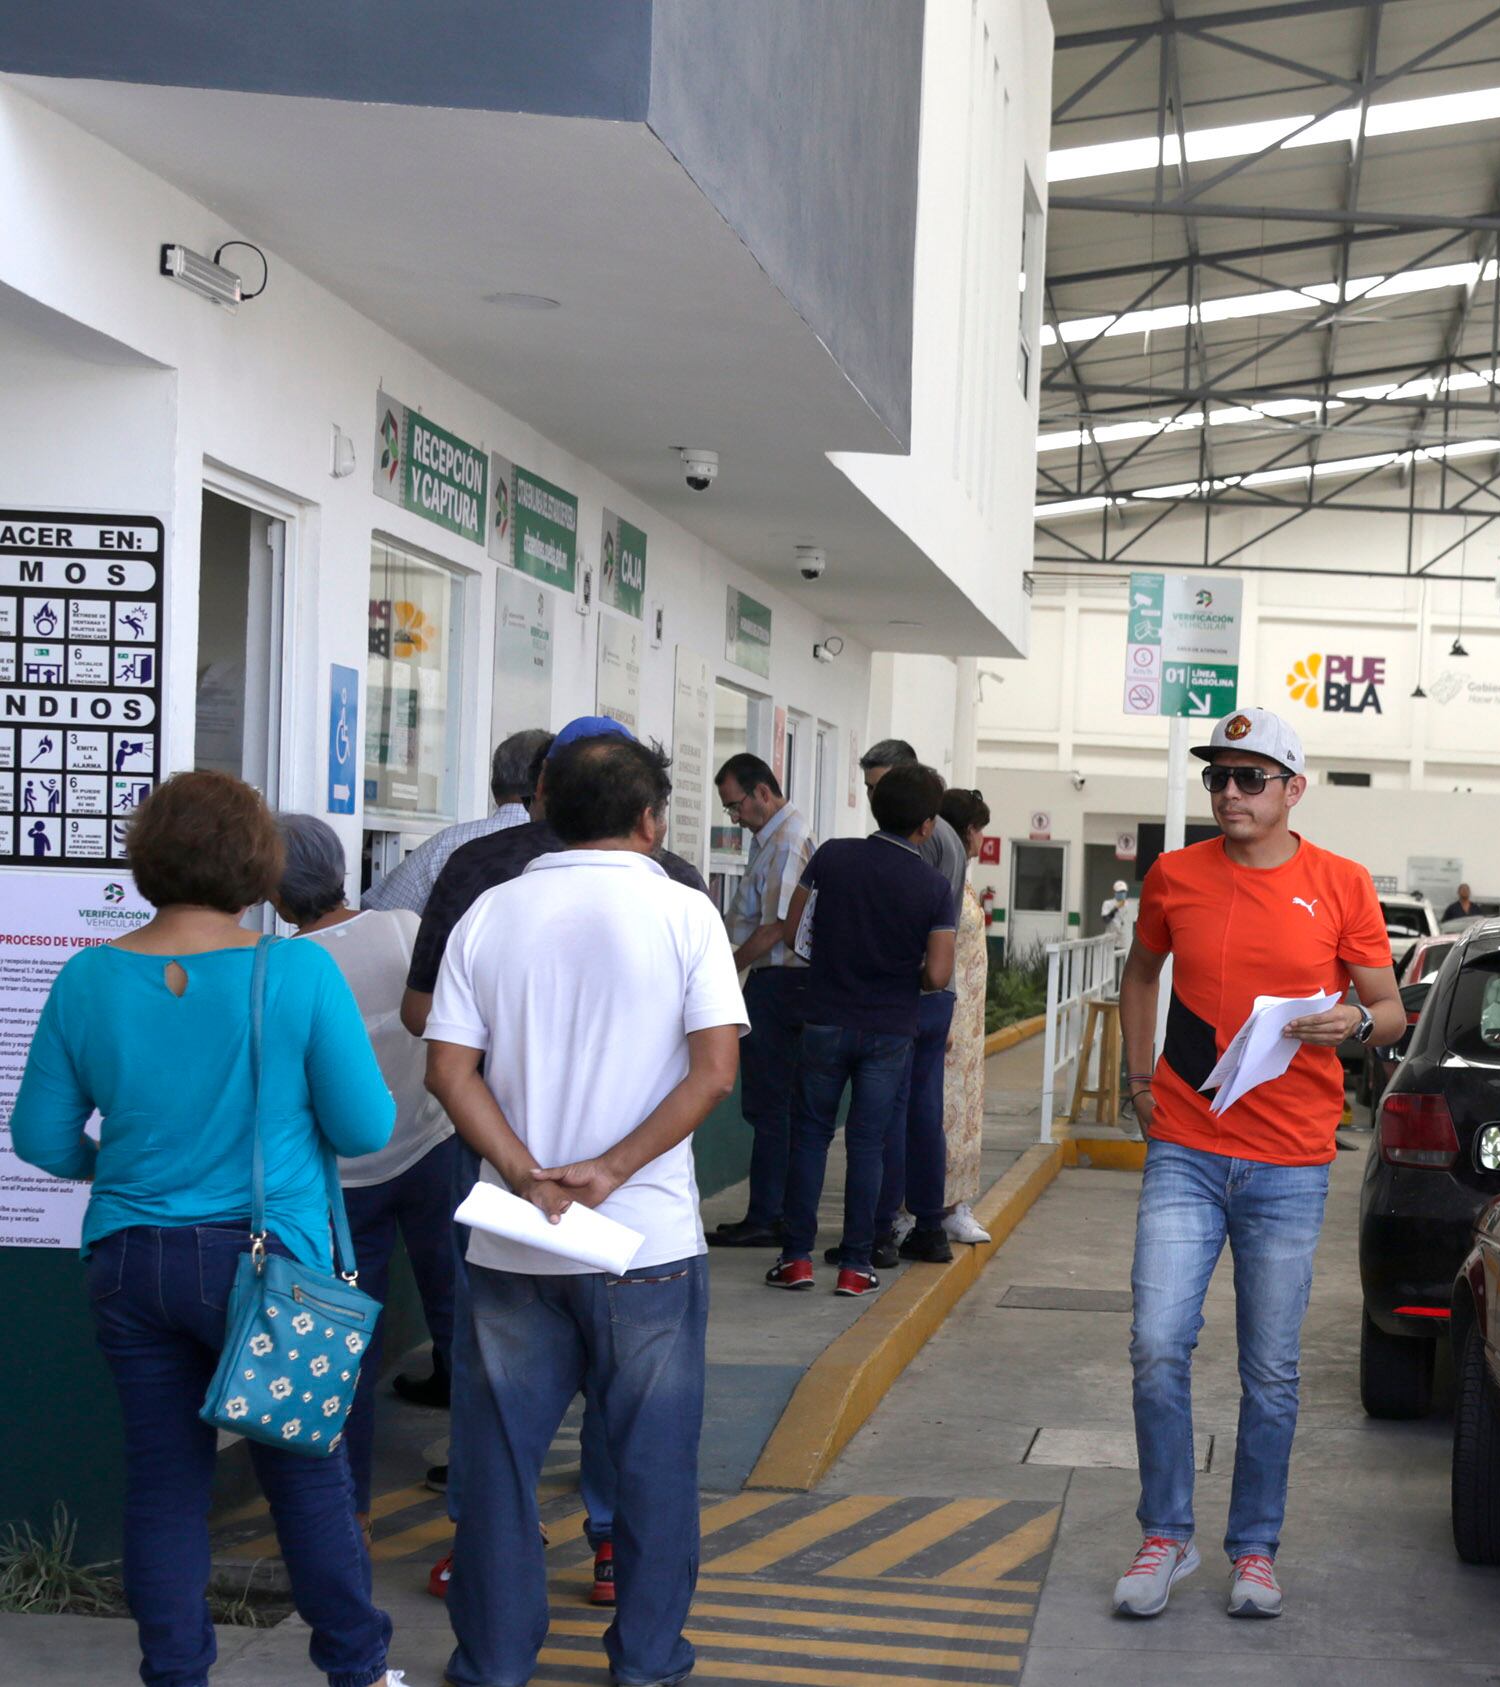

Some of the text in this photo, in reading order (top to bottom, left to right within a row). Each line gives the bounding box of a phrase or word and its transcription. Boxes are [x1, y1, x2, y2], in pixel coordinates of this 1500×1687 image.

[413, 425, 483, 495] RECEPCIÓN
[411, 466, 422, 504] Y
[422, 472, 479, 533] CAPTURA
[0, 525, 142, 550] ACER EN:
[621, 551, 642, 592] CAJA
[72, 602, 79, 613] 3
[1173, 611, 1234, 624] VERIFICACIÓN
[74, 648, 82, 660] 6
[1165, 667, 1185, 684] 01
[1191, 669, 1217, 678] LÍNEA
[1325, 654, 1386, 685] PUE
[1191, 677, 1234, 688] GASOLINA
[1322, 682, 1383, 715] BLA
[70, 733, 78, 745] 3
[70, 777, 78, 788] 6
[71, 821, 79, 833] 9
[78, 909, 151, 920] VERIFICACIÓN
[86, 918, 142, 928] VEHICULAR
[0, 934, 52, 947] PROCESO
[53, 936, 68, 947] DE
[16, 1185, 49, 1193] Parabrisas
